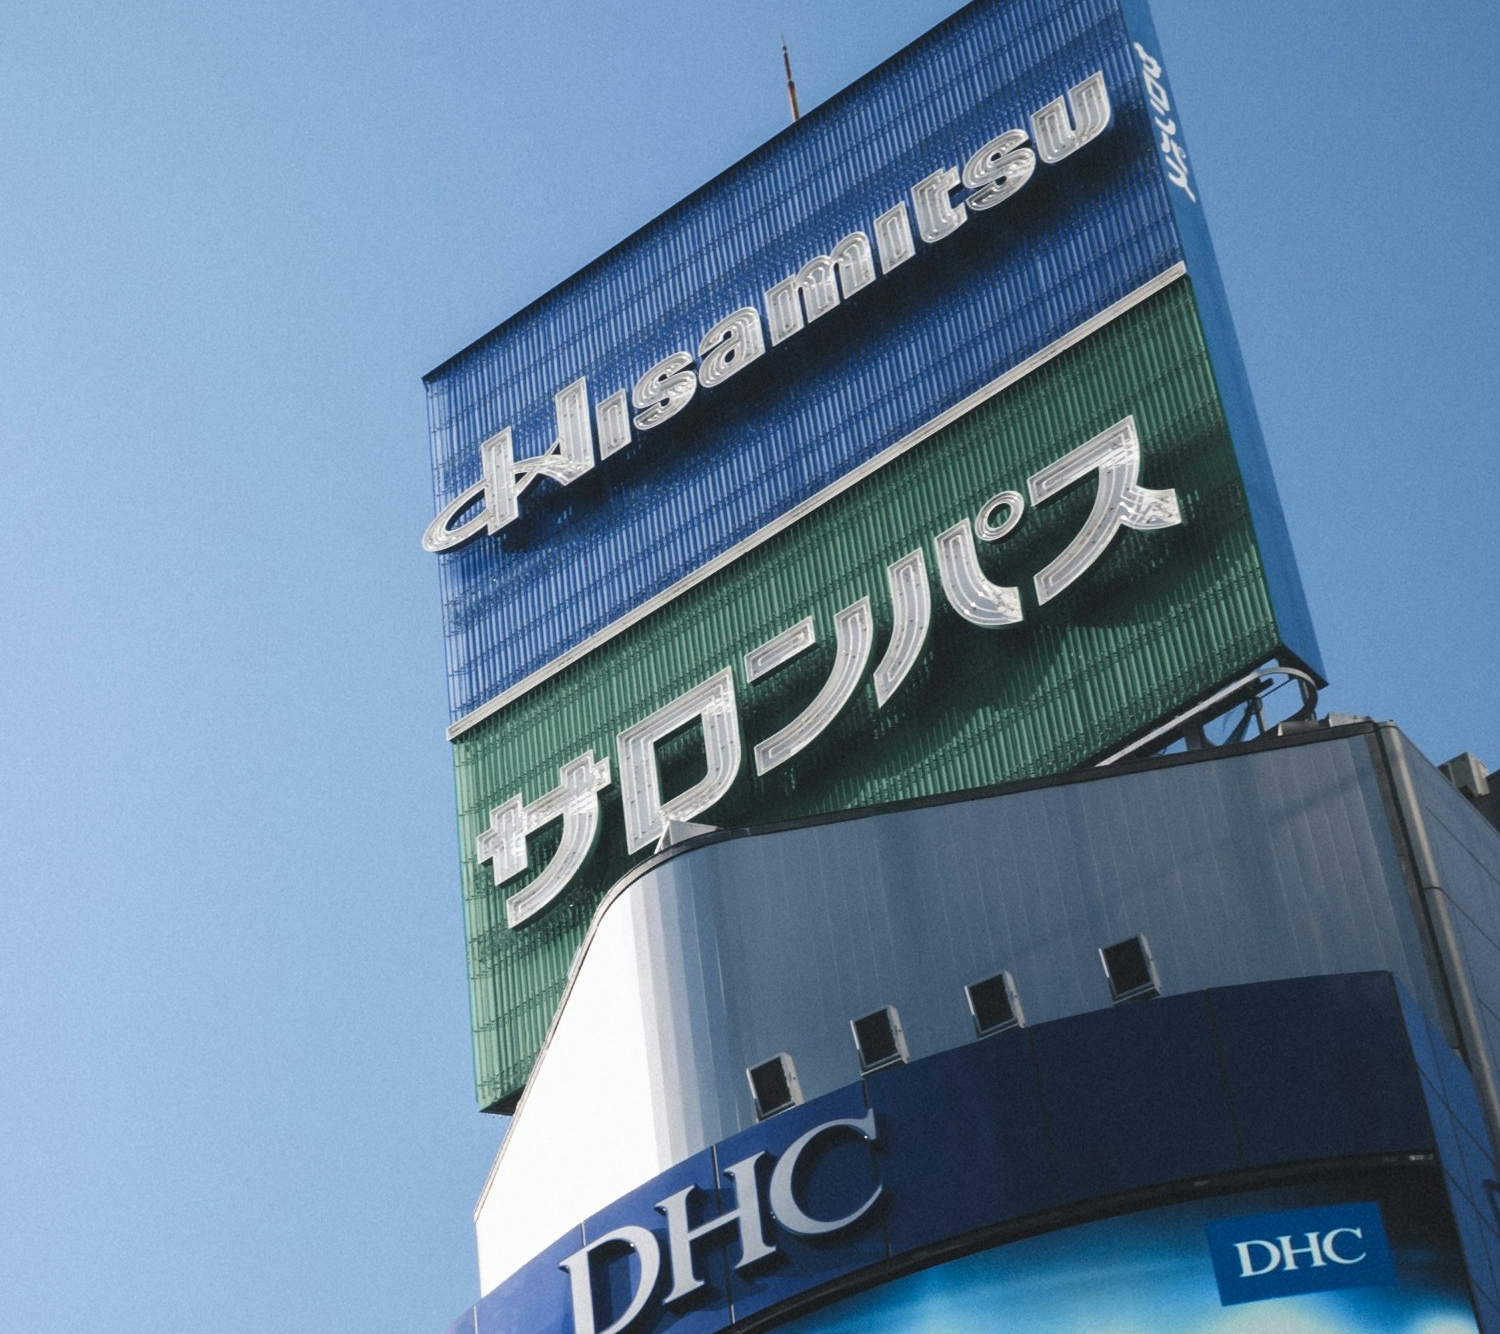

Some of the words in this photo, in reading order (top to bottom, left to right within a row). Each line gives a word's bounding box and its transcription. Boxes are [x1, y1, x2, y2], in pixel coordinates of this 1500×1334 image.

[421, 69, 1112, 554] Hisamitsu
[476, 415, 1181, 929] サロンパス
[1232, 1224, 1368, 1279] DHC
